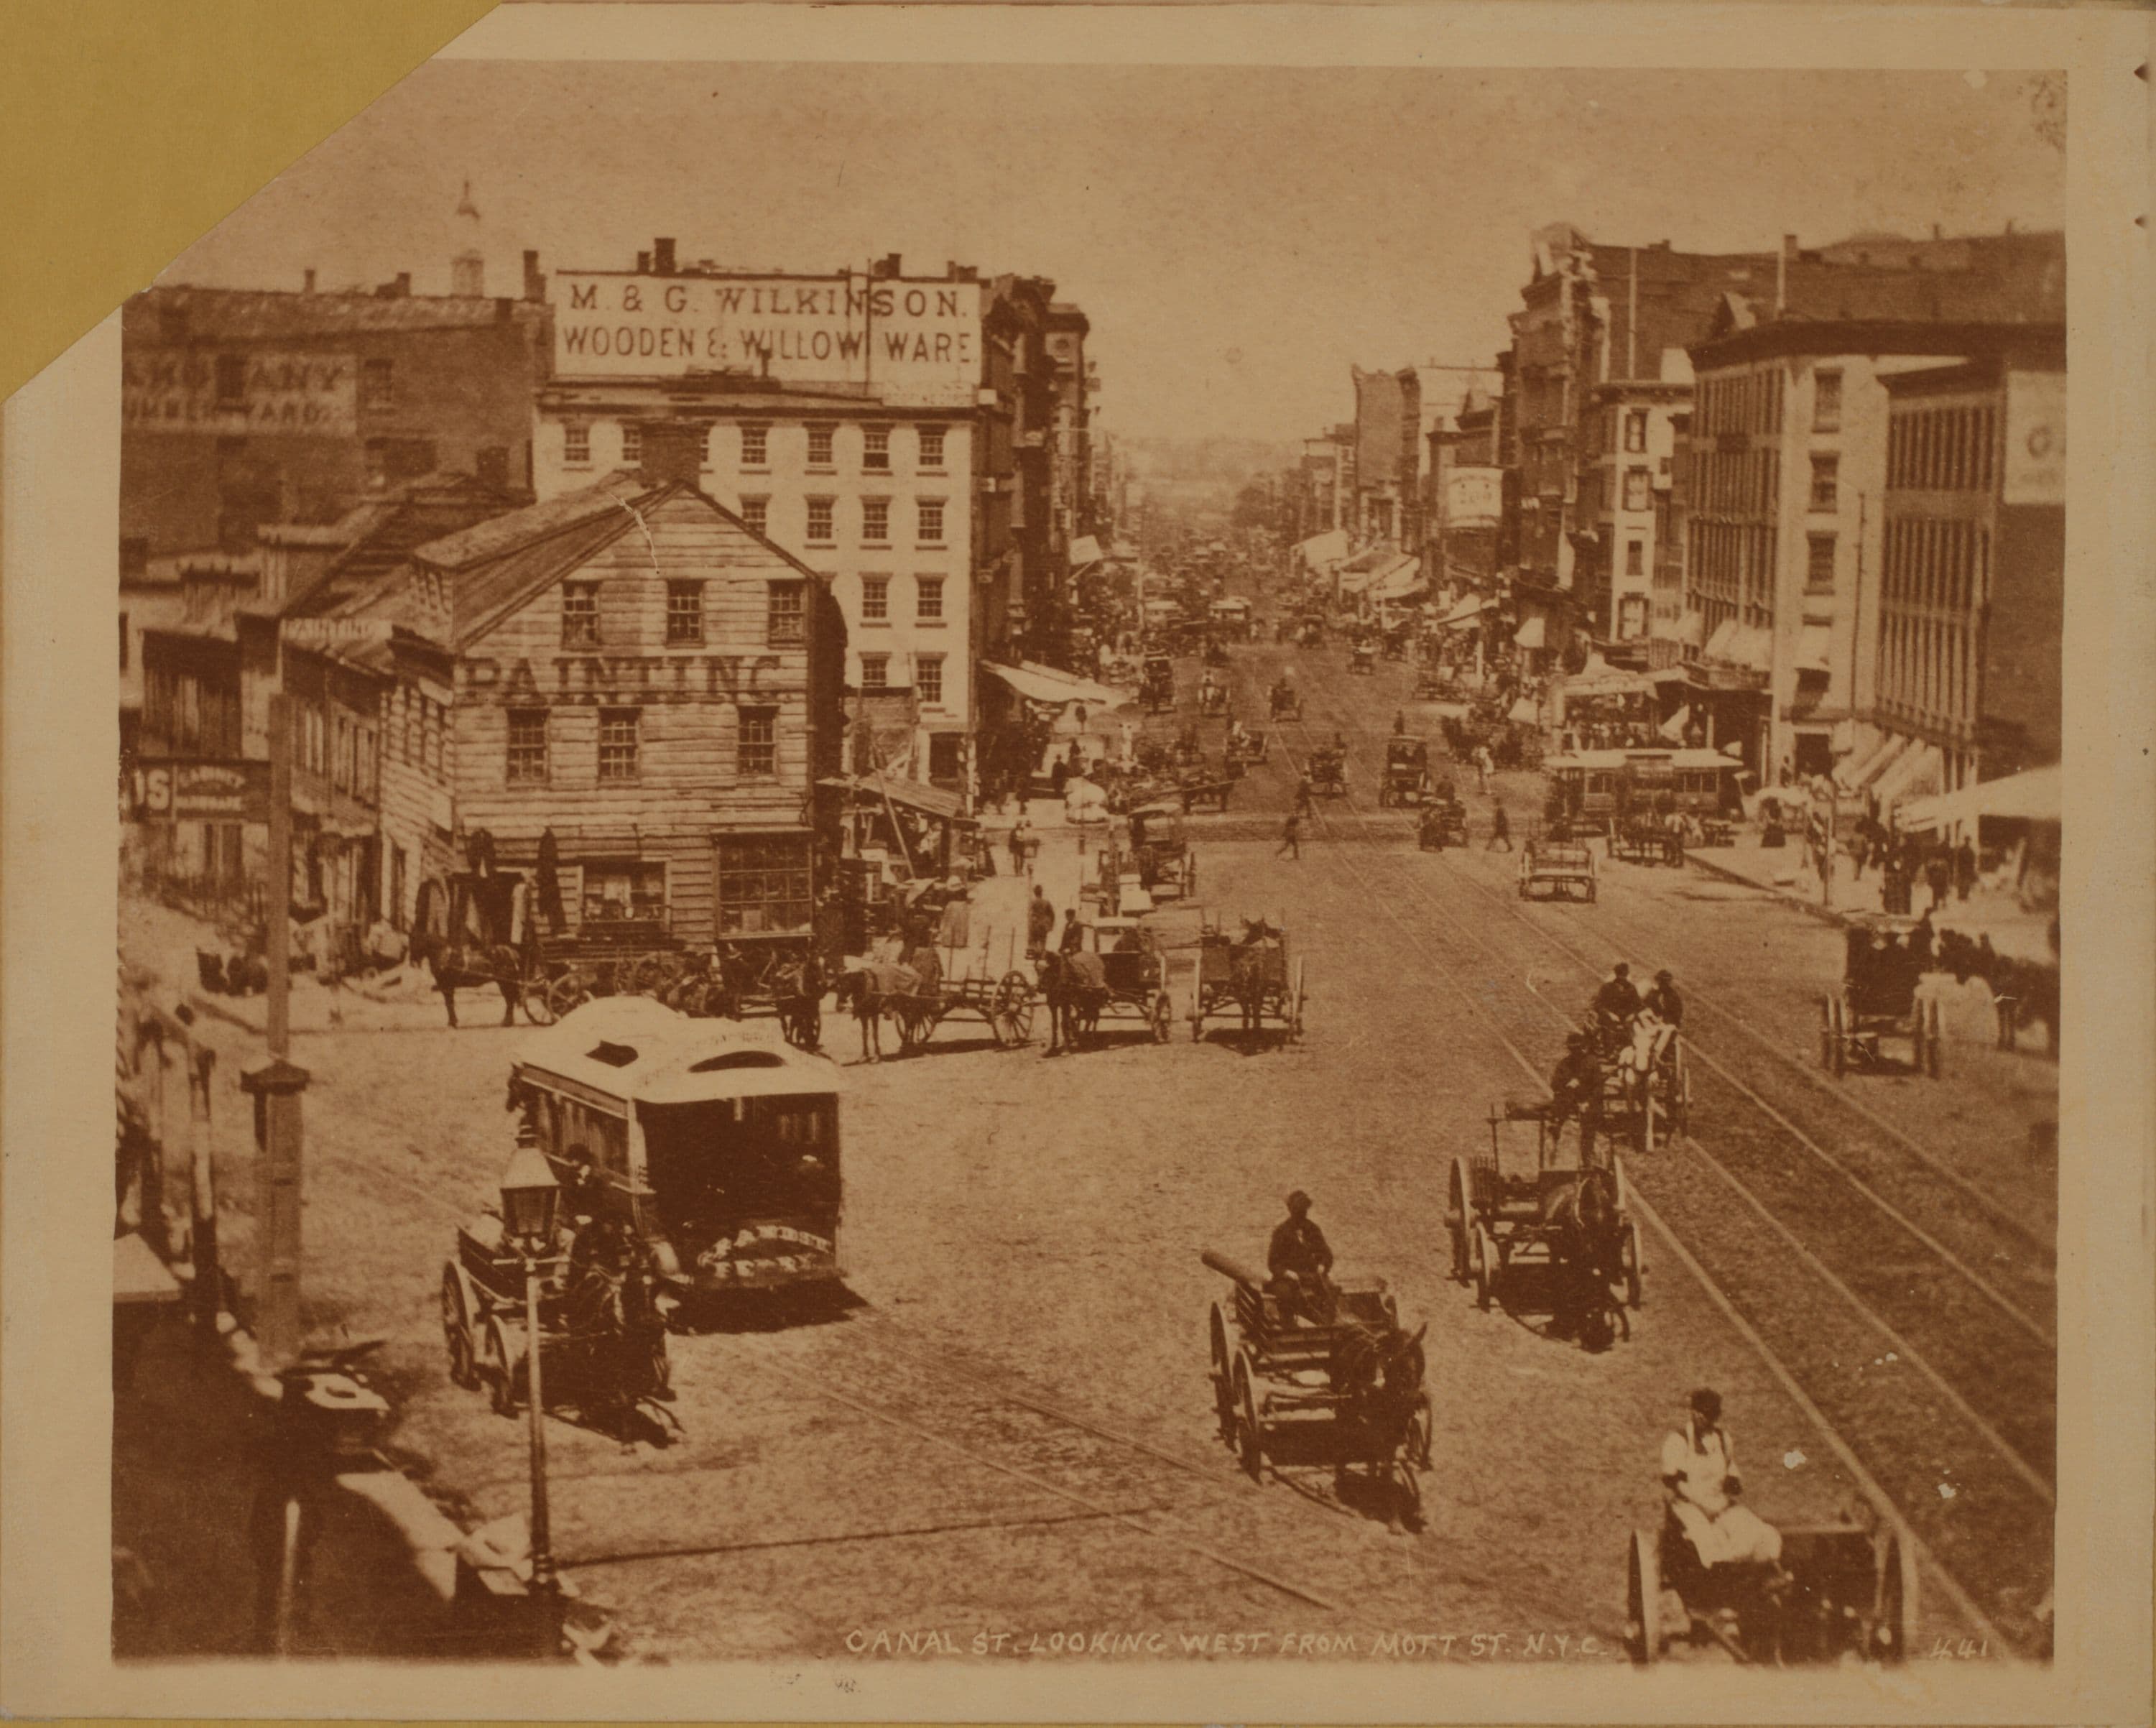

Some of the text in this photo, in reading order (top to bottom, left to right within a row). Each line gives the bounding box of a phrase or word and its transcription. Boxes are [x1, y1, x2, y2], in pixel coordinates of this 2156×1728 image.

[623, 285, 642, 312] &
[563, 326, 695, 357] WOODEN
[707, 327, 727, 359] &
[741, 328, 863, 361] WILLOW
